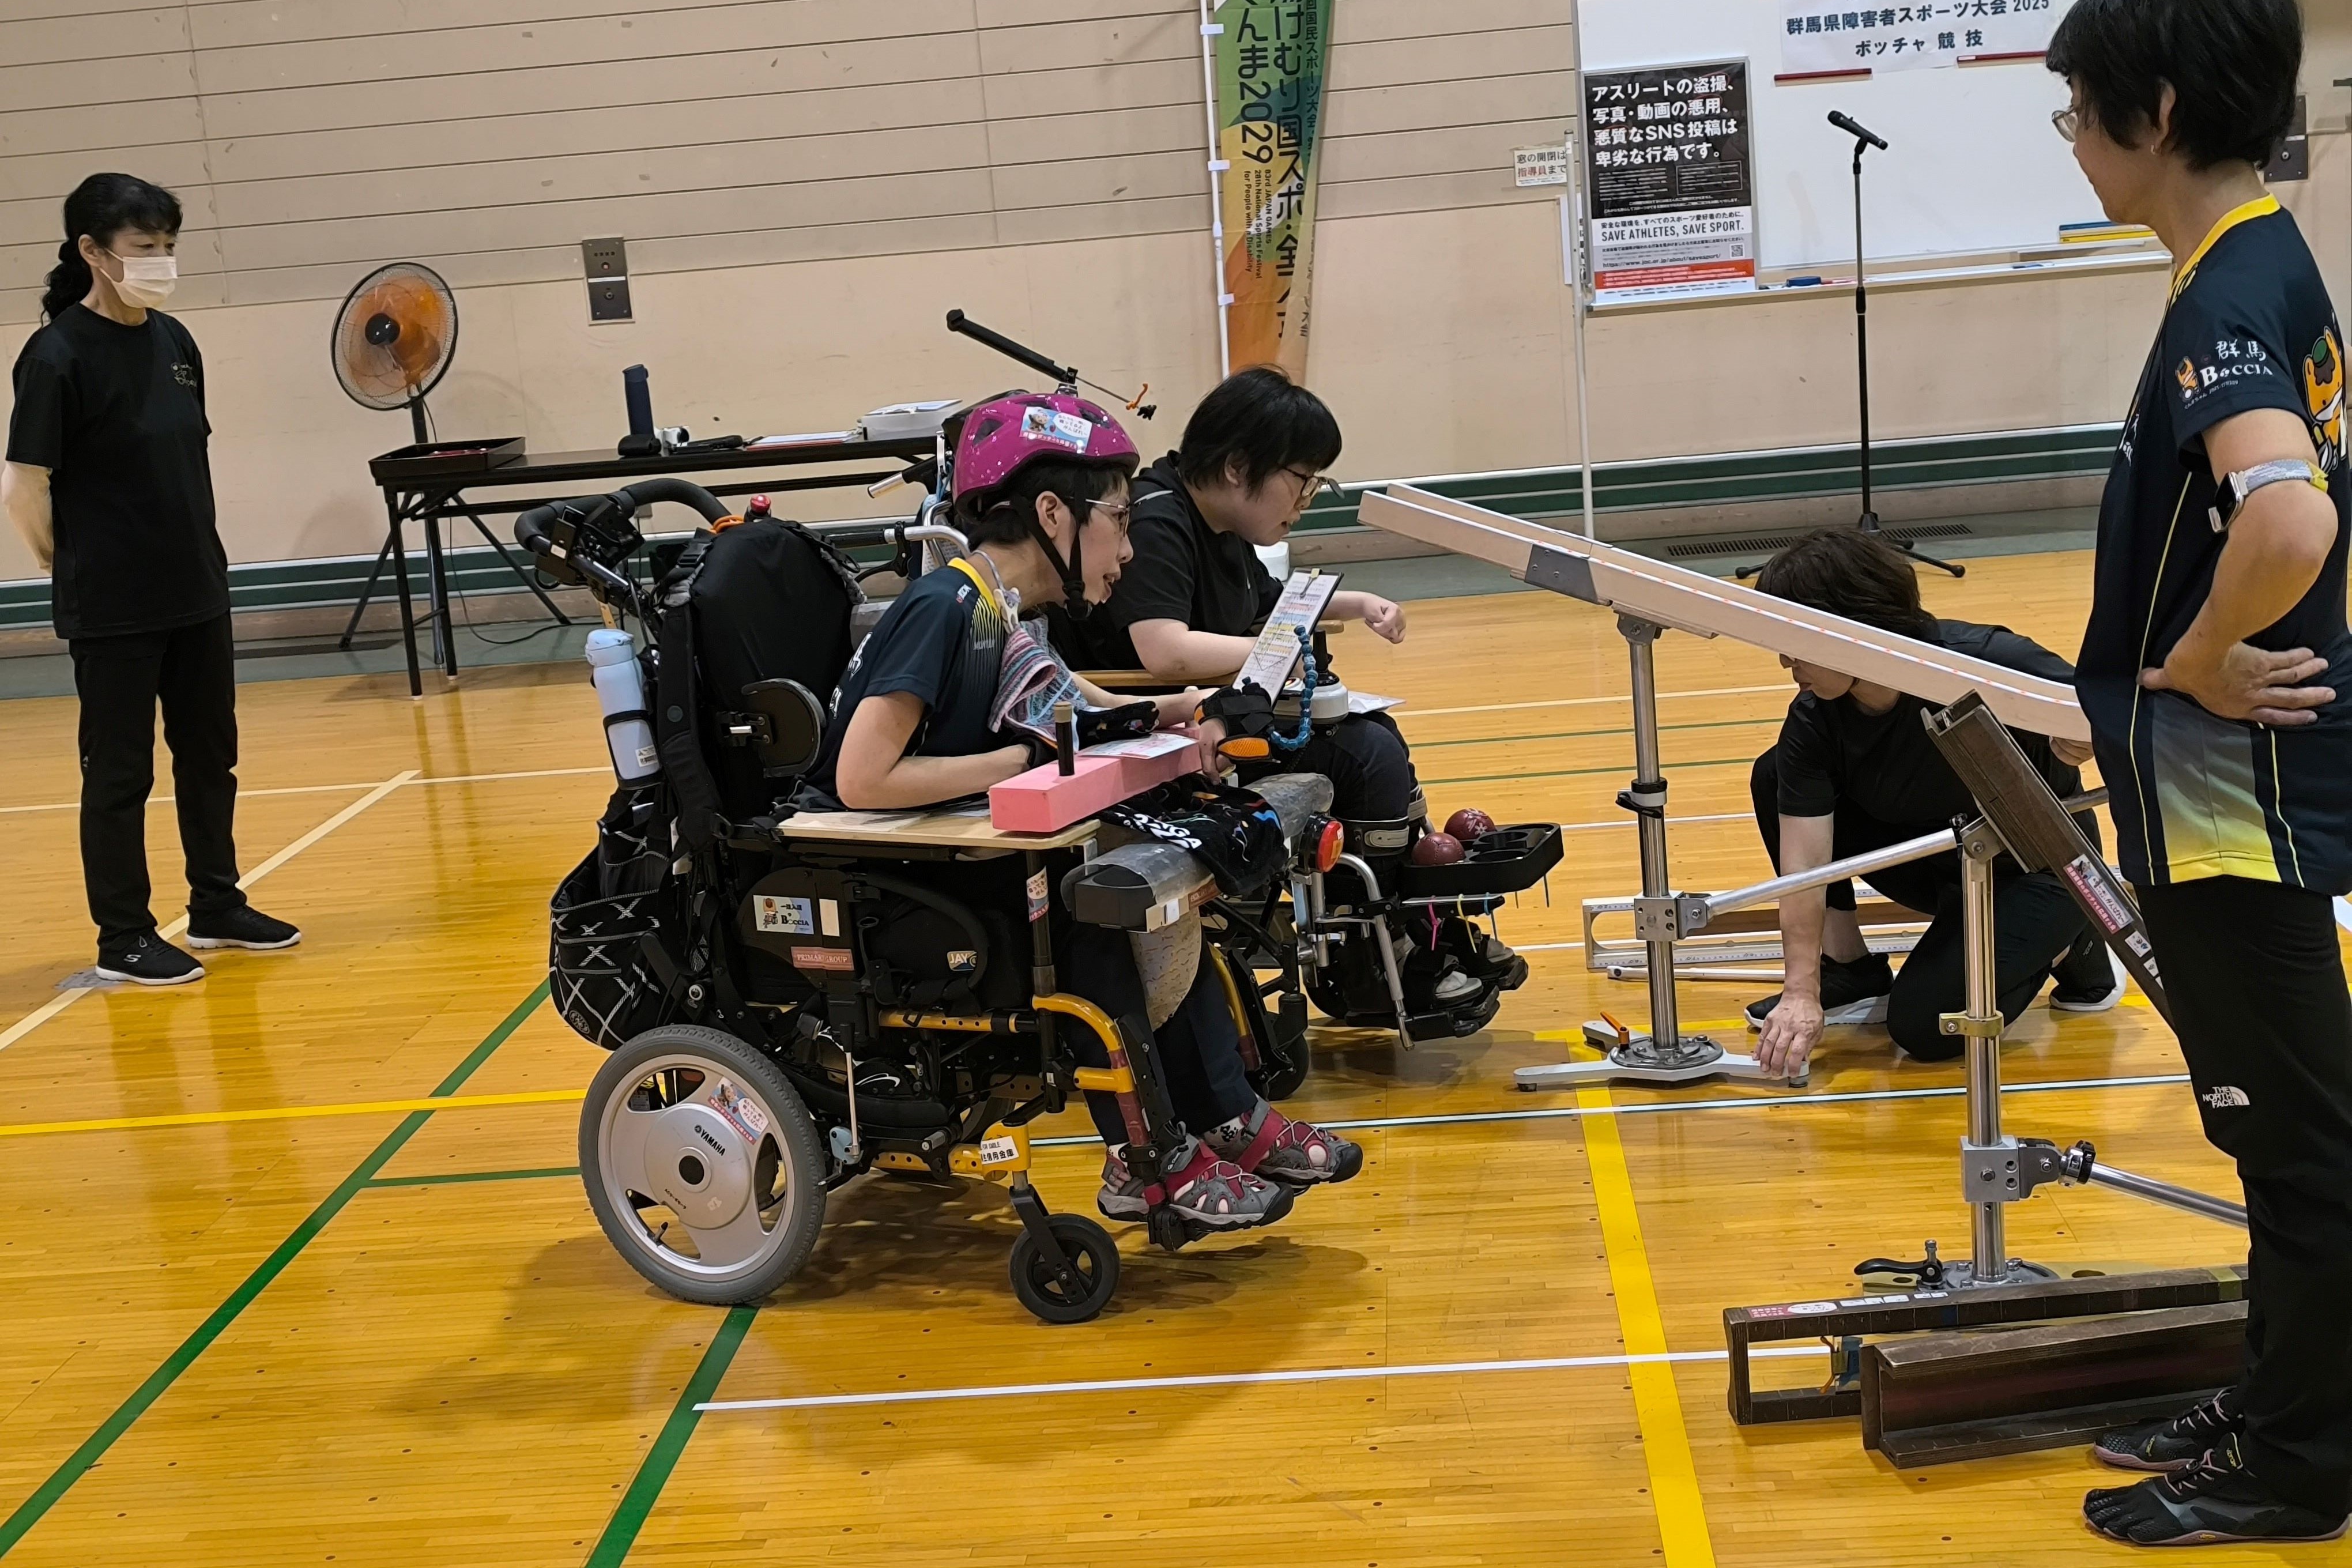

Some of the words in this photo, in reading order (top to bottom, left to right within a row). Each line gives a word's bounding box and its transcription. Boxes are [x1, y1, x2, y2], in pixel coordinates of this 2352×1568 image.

[1786, 0, 2007, 35] 群馬県障害者スポーツ大会
[1592, 75, 1733, 101] アスリートの盗撮、
[1593, 97, 1728, 124] 写真・動画の悪用、
[1595, 142, 1720, 168] 卑劣な行為です。
[1243, 171, 1252, 182] for
[1518, 164, 1567, 178] 指導員まで
[1243, 184, 1252, 210] People
[1254, 189, 1263, 221] National
[1265, 189, 1273, 214] JAPAN
[1245, 212, 1253, 228] with
[1601, 229, 1626, 242] SAVE
[1629, 225, 1679, 239] ATHLETES,
[1682, 223, 1706, 235] SAVE
[1709, 220, 1744, 232] SPORT.
[1255, 223, 1263, 248] Sports
[1245, 237, 1253, 272] Disability
[950, 953, 968, 964] JAY
[2212, 1099, 2235, 1109] FACE
[701, 1129, 726, 1156] YAMAHA
